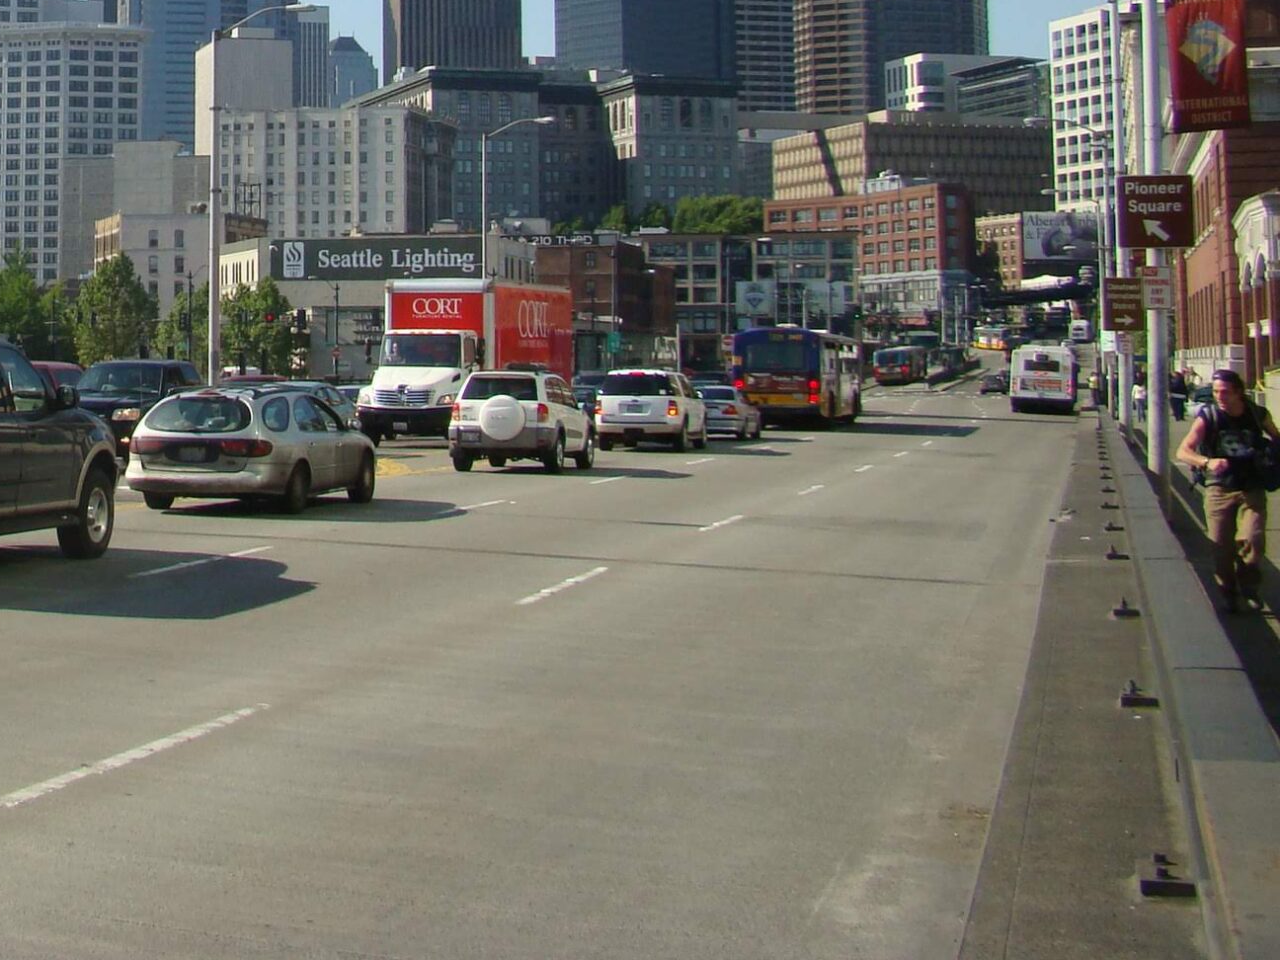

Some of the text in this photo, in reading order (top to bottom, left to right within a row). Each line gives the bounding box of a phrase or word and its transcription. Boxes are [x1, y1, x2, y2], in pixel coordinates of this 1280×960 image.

[1124, 182, 1184, 195] Pioneer
[1128, 199, 1182, 214] Square
[531, 235, 551, 246] 210
[318, 247, 475, 273] Seattle Lighting
[412, 298, 462, 315] CORT
[518, 300, 549, 338] CORT
